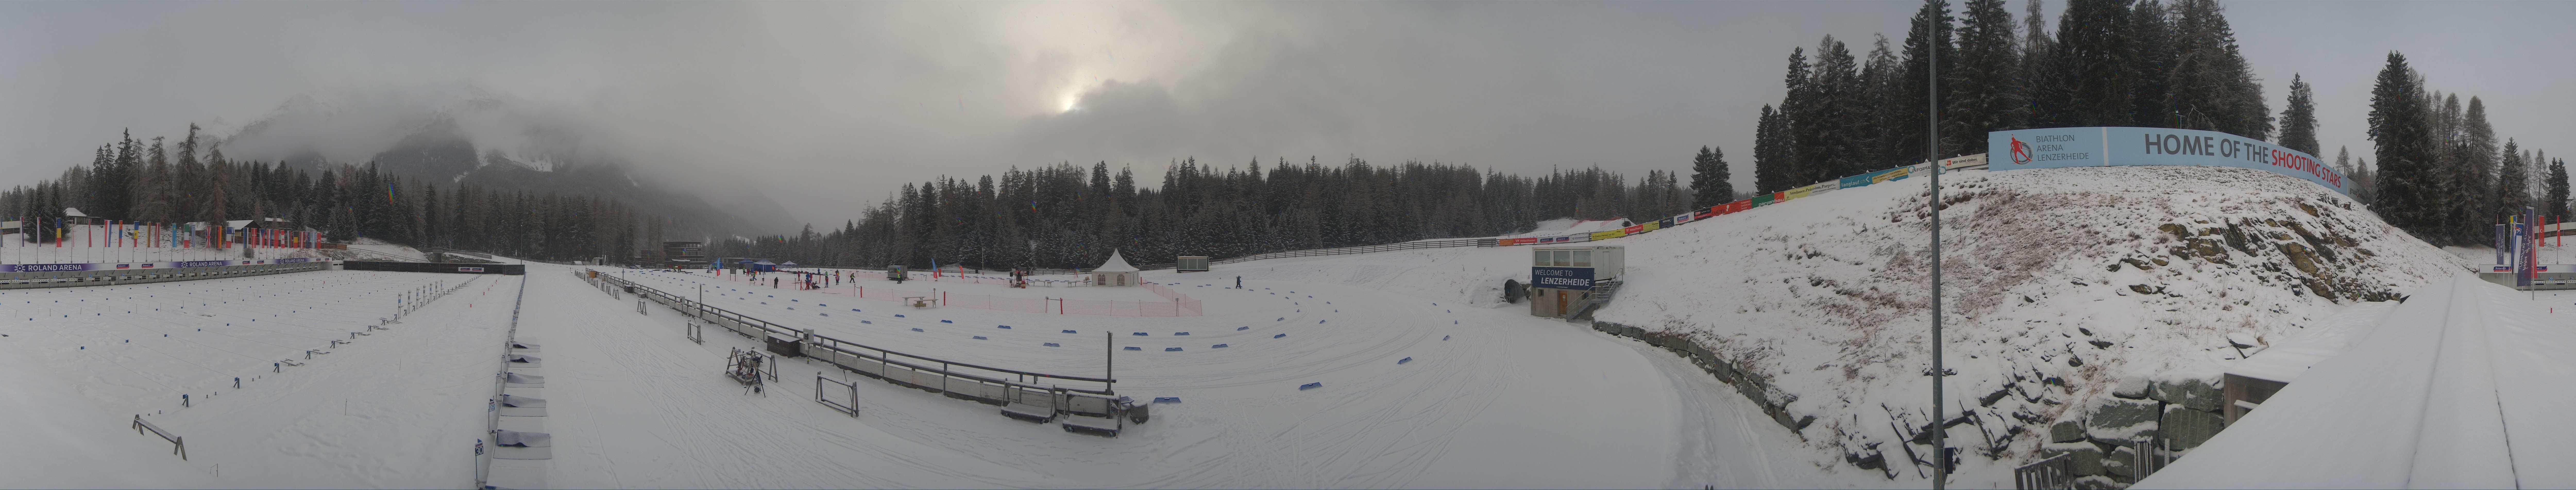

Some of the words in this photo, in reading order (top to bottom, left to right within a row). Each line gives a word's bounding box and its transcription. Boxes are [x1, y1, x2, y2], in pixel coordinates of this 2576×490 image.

[2145, 134, 2214, 156] HOME
[2221, 138, 2240, 159] OF
[2244, 143, 2268, 164] THE
[2272, 149, 2320, 177] SHOOTING
[2322, 167, 2341, 188] STARS
[1541, 277, 1590, 286] LENZERHEIDE
[476, 446, 483, 455] 30
